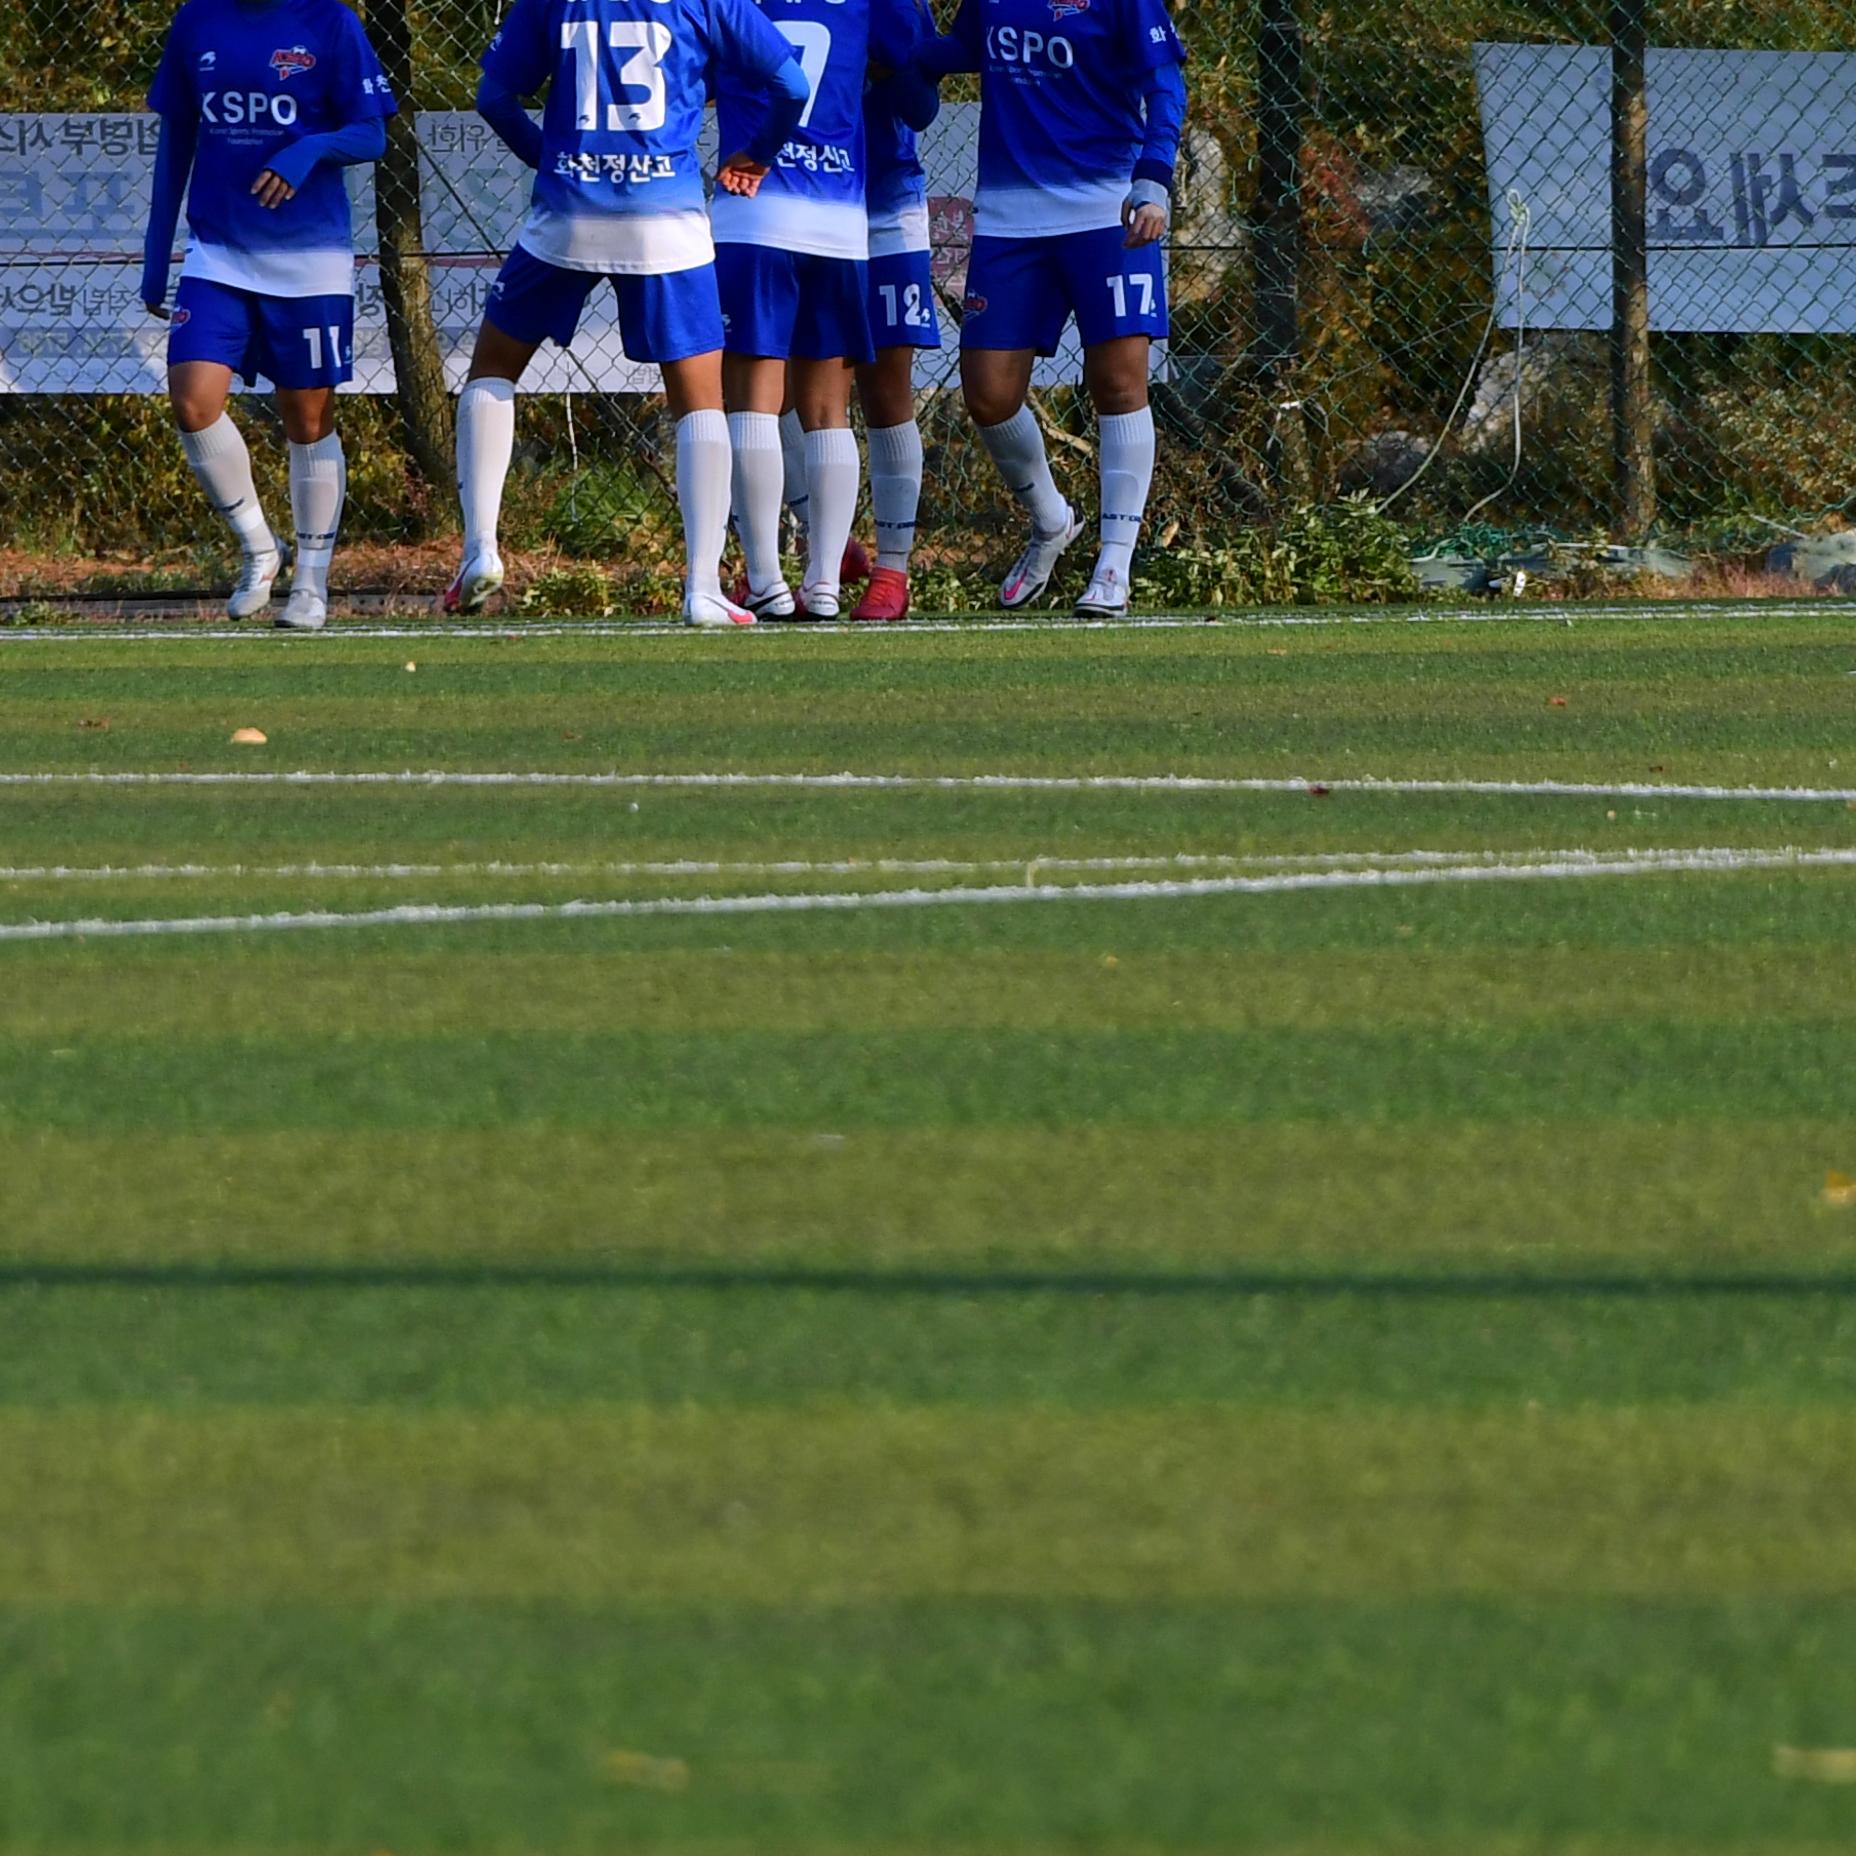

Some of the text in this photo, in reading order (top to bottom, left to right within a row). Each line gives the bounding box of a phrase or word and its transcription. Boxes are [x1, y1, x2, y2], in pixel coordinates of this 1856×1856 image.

[561, 20, 671, 131] 13
[771, 20, 831, 128] 7
[200, 90, 297, 126] KSPO
[554, 151, 676, 184] 화천정산고
[776, 141, 855, 173] 천정산고
[878, 283, 922, 326] 12
[1106, 273, 1153, 317] 17
[302, 326, 342, 369] 11
